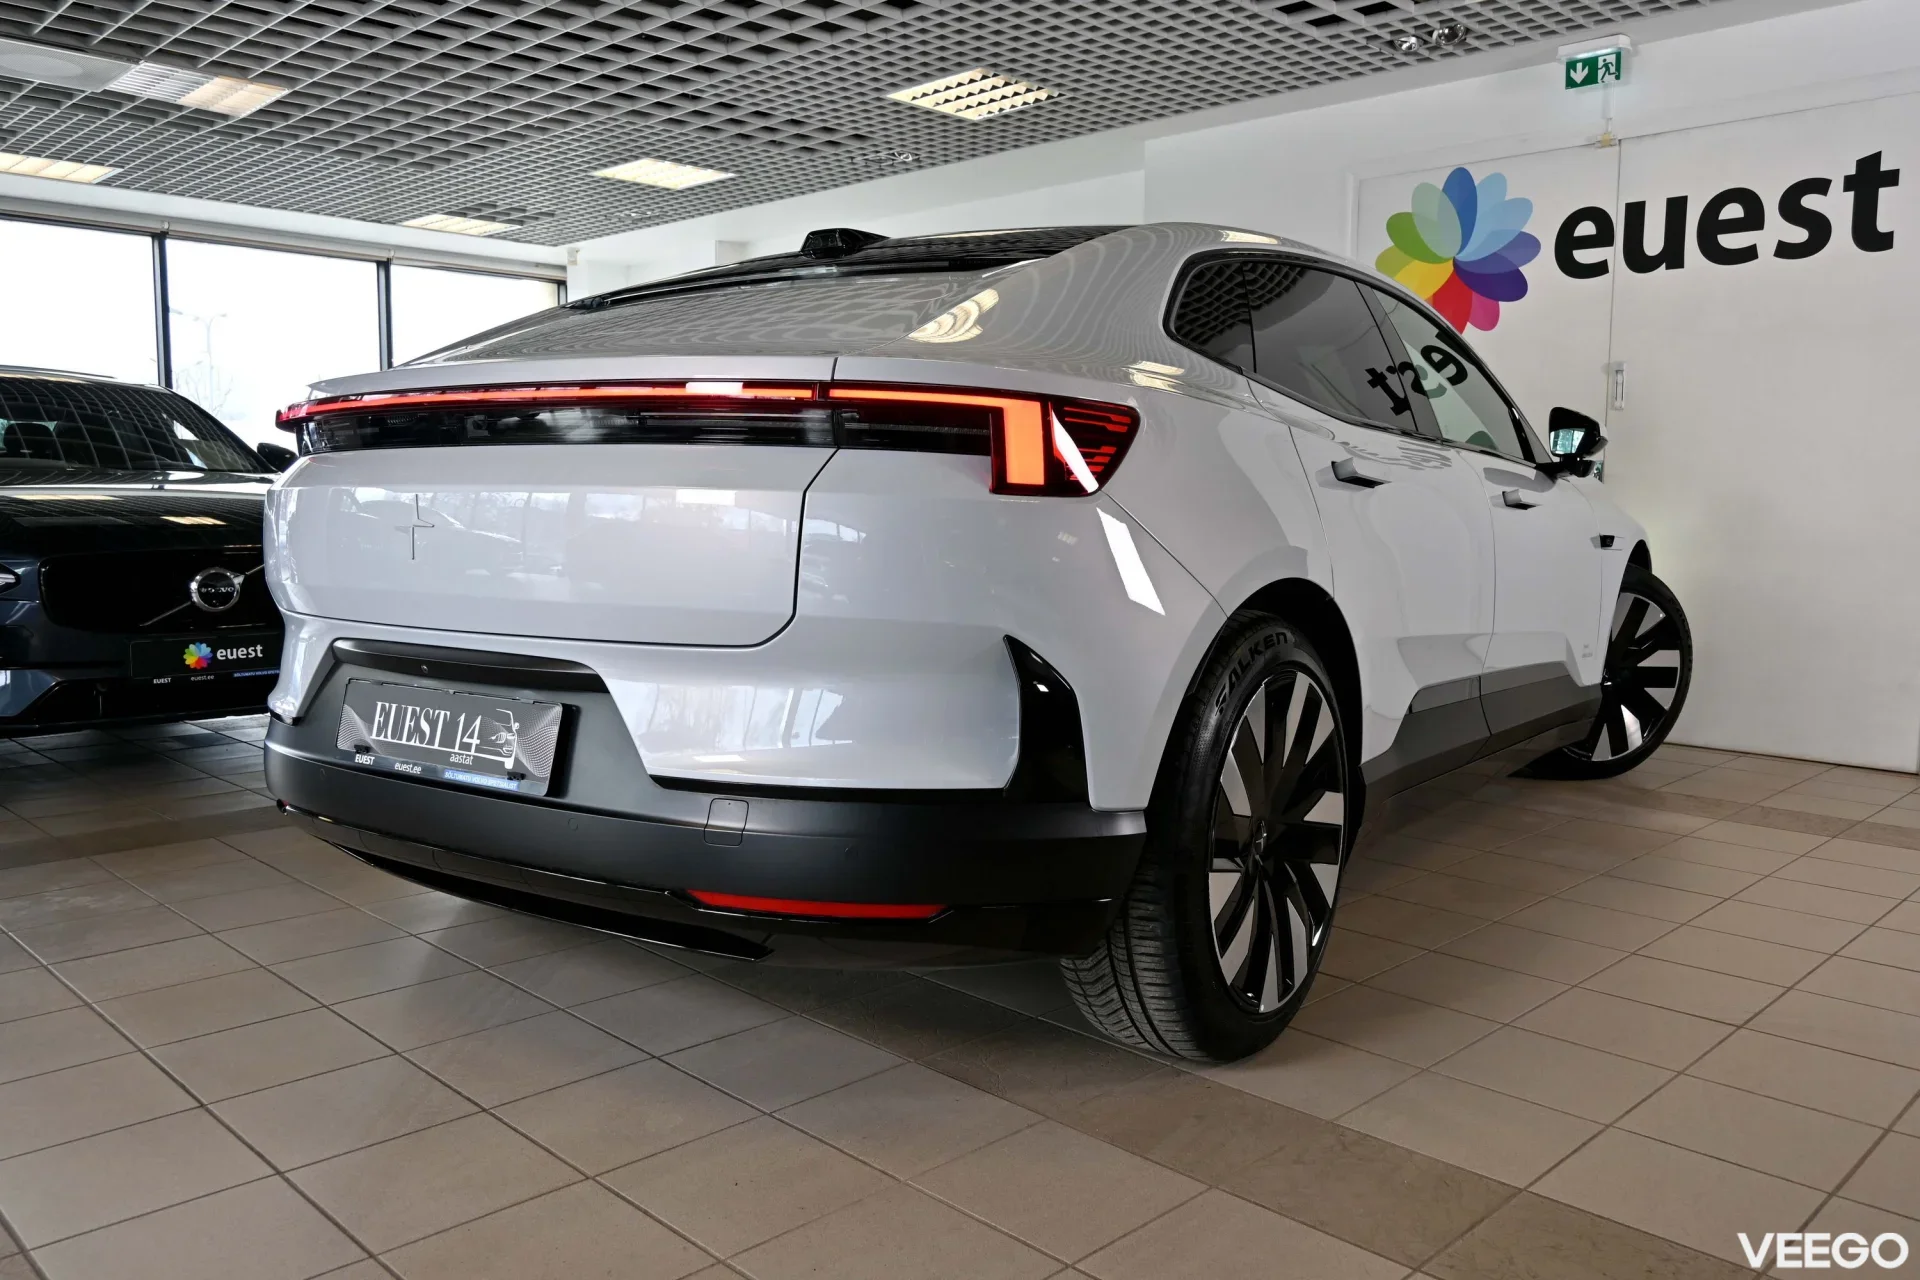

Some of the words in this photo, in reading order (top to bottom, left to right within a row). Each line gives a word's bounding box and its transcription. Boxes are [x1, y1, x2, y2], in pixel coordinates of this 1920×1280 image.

[1553, 150, 1900, 279] euest
[216, 643, 263, 660] euest
[190, 674, 215, 682] euest.ee
[1215, 631, 1288, 716] FALKEN
[371, 701, 450, 748] EUEST
[455, 712, 483, 754] 14
[354, 754, 375, 765] EUEST
[449, 752, 473, 766] aastat
[394, 762, 422, 774] euest.ee
